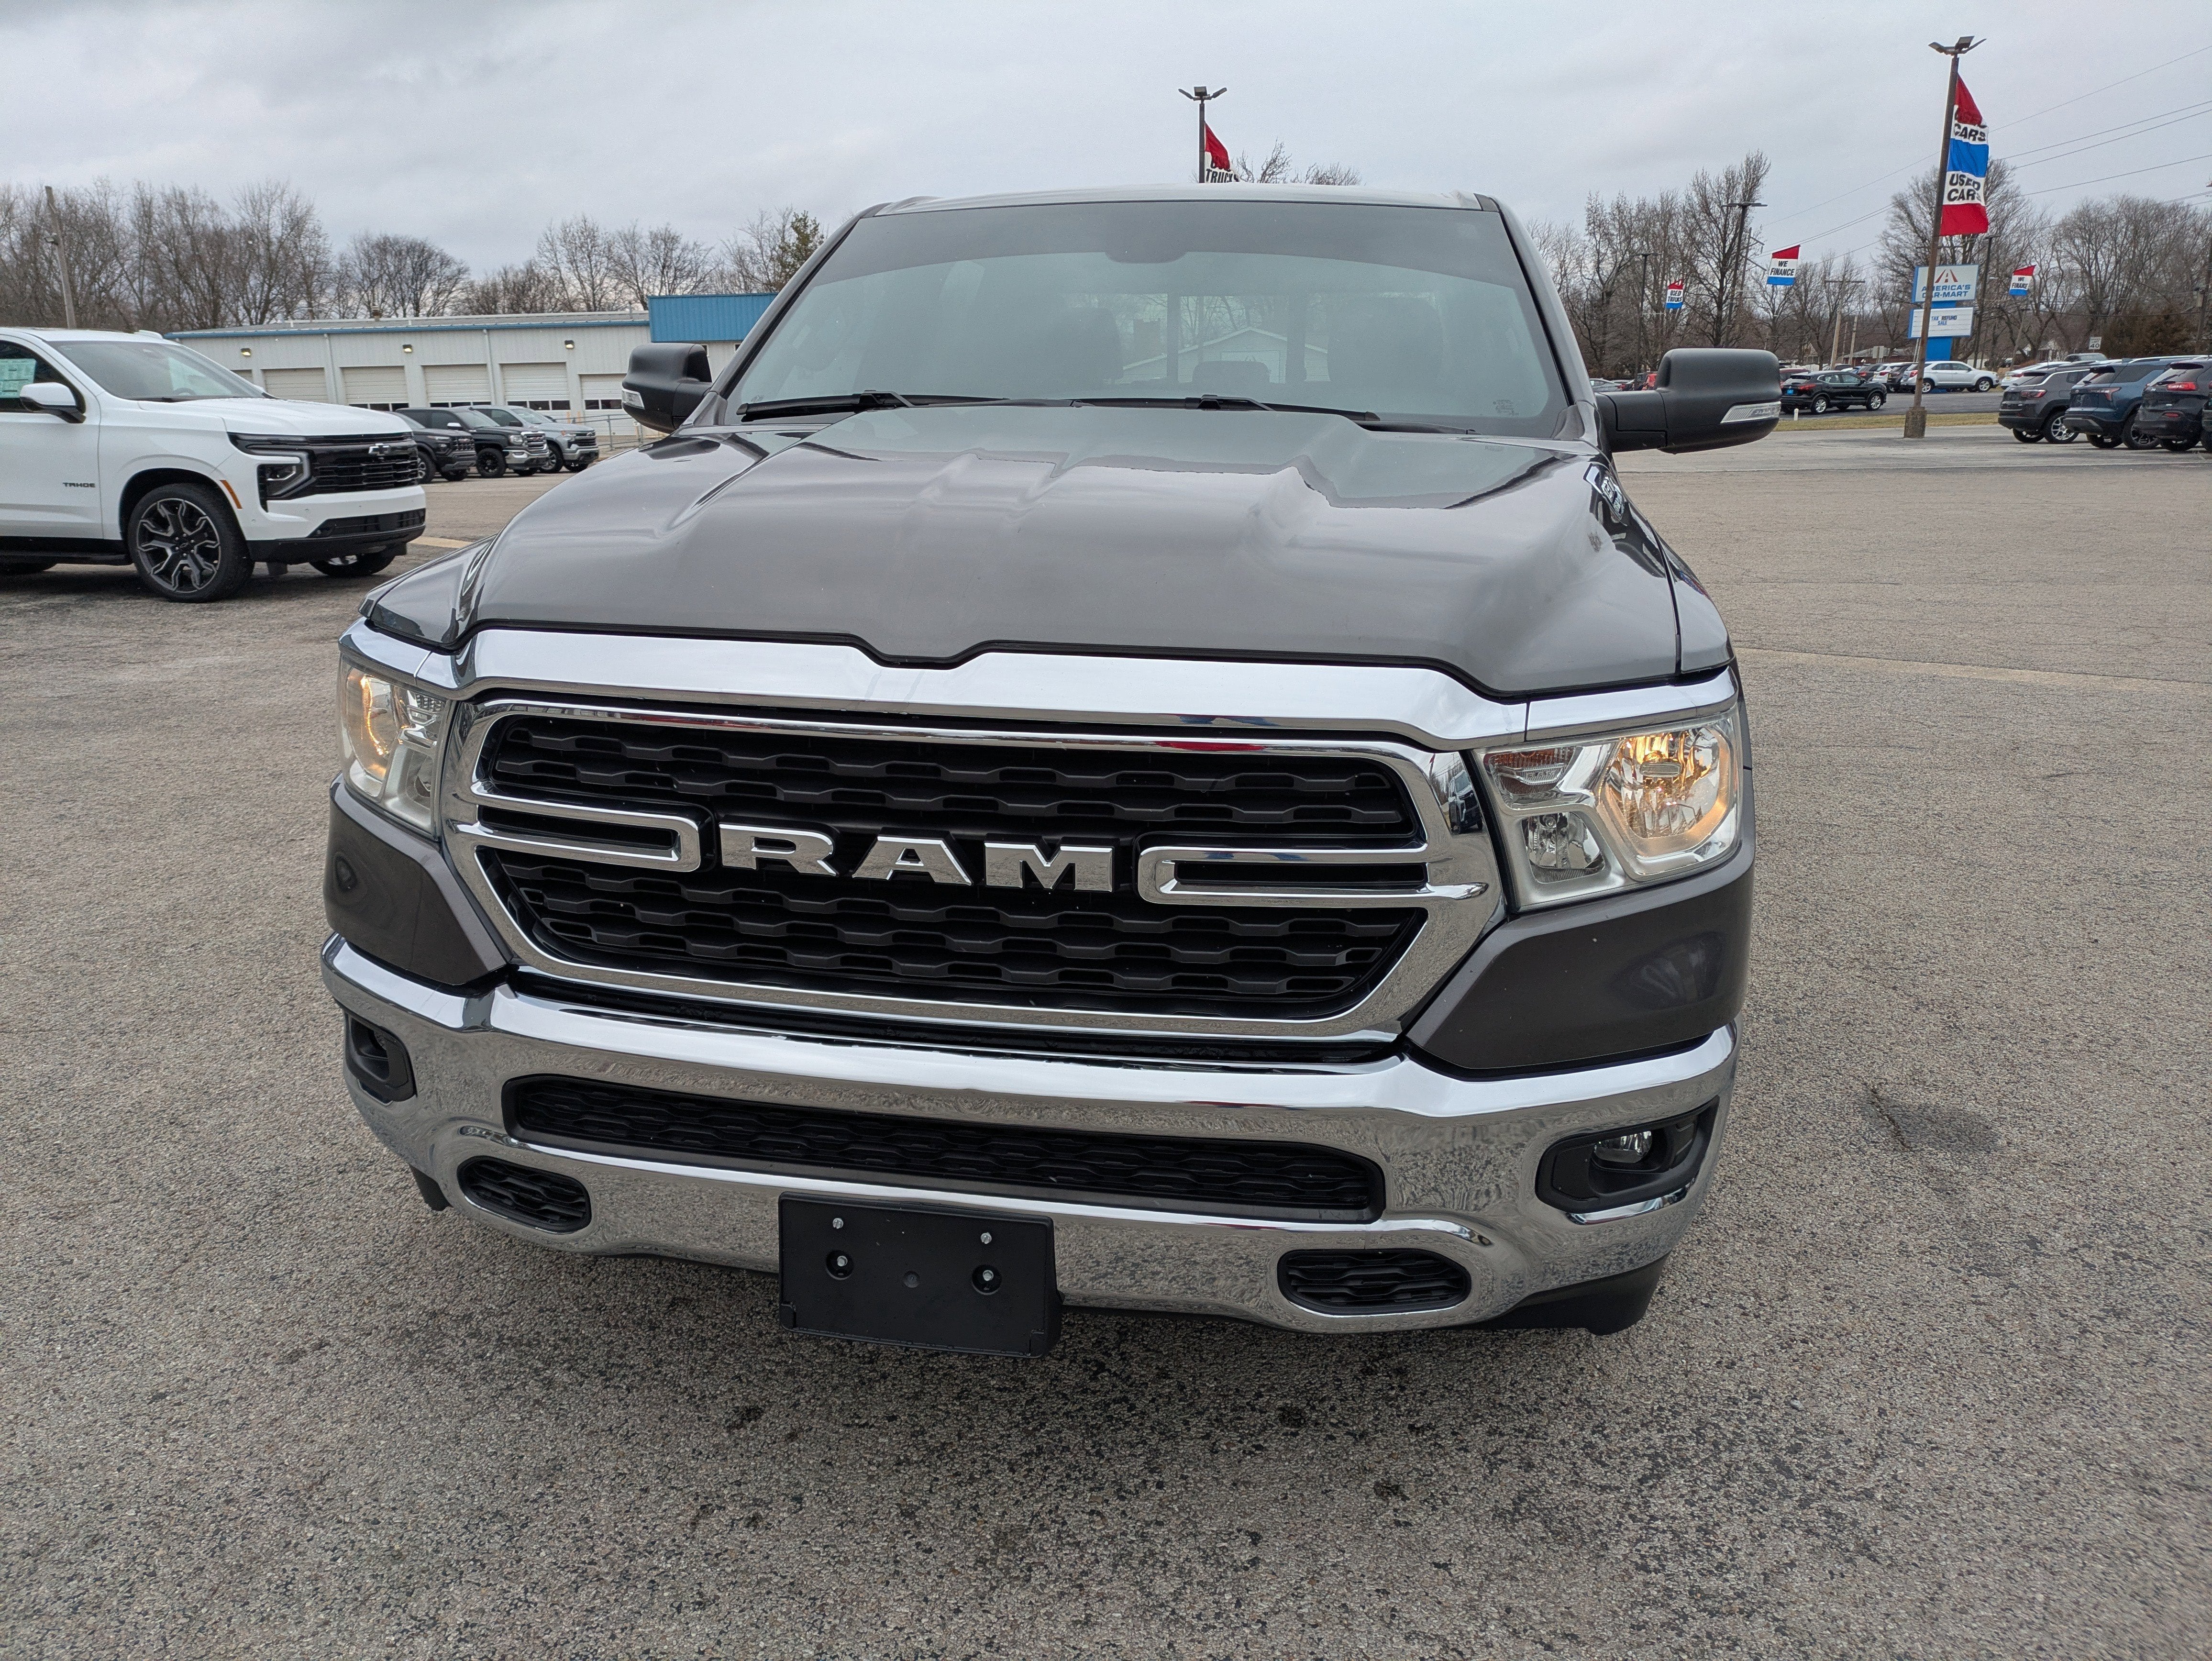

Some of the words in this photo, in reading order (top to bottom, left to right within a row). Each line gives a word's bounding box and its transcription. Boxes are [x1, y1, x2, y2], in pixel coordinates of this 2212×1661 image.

[1954, 123, 1986, 141] CARS
[1949, 174, 1980, 190] USED
[719, 823, 1113, 893] RAM
